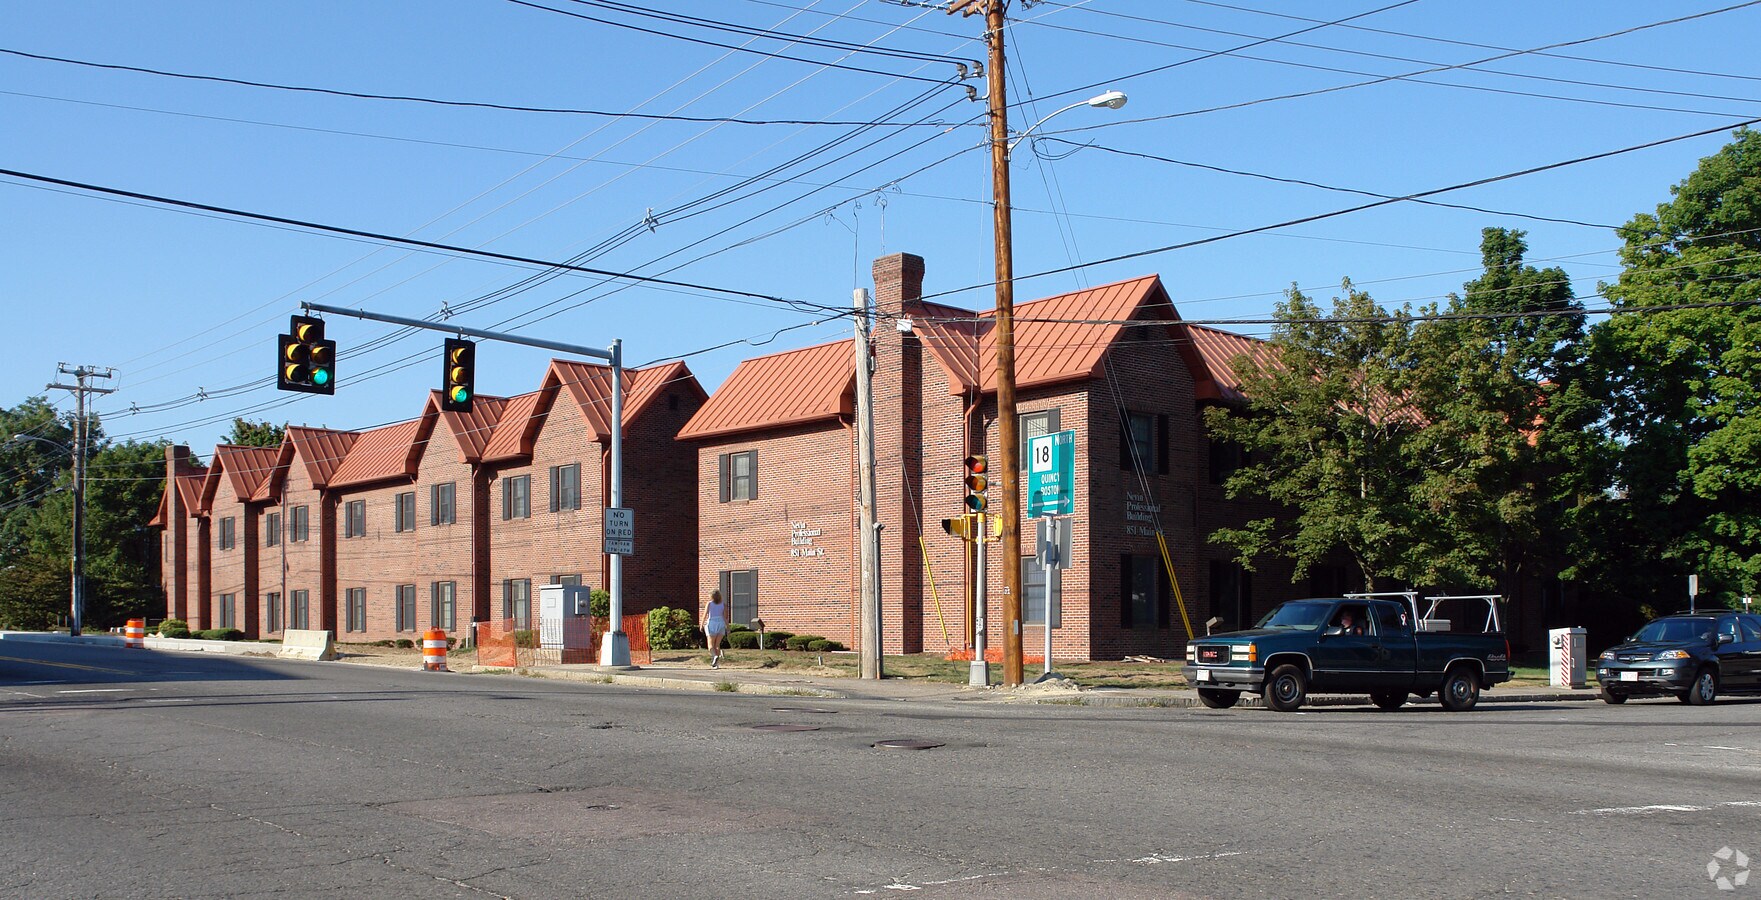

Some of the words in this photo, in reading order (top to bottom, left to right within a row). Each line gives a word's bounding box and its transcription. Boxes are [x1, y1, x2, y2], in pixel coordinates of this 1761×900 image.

[1055, 434, 1072, 446] NORTH
[1036, 446, 1049, 464] 18
[1126, 501, 1161, 512] Professional
[1126, 511, 1152, 522] Building
[1126, 525, 1137, 535] 851
[1140, 526, 1155, 536] Main
